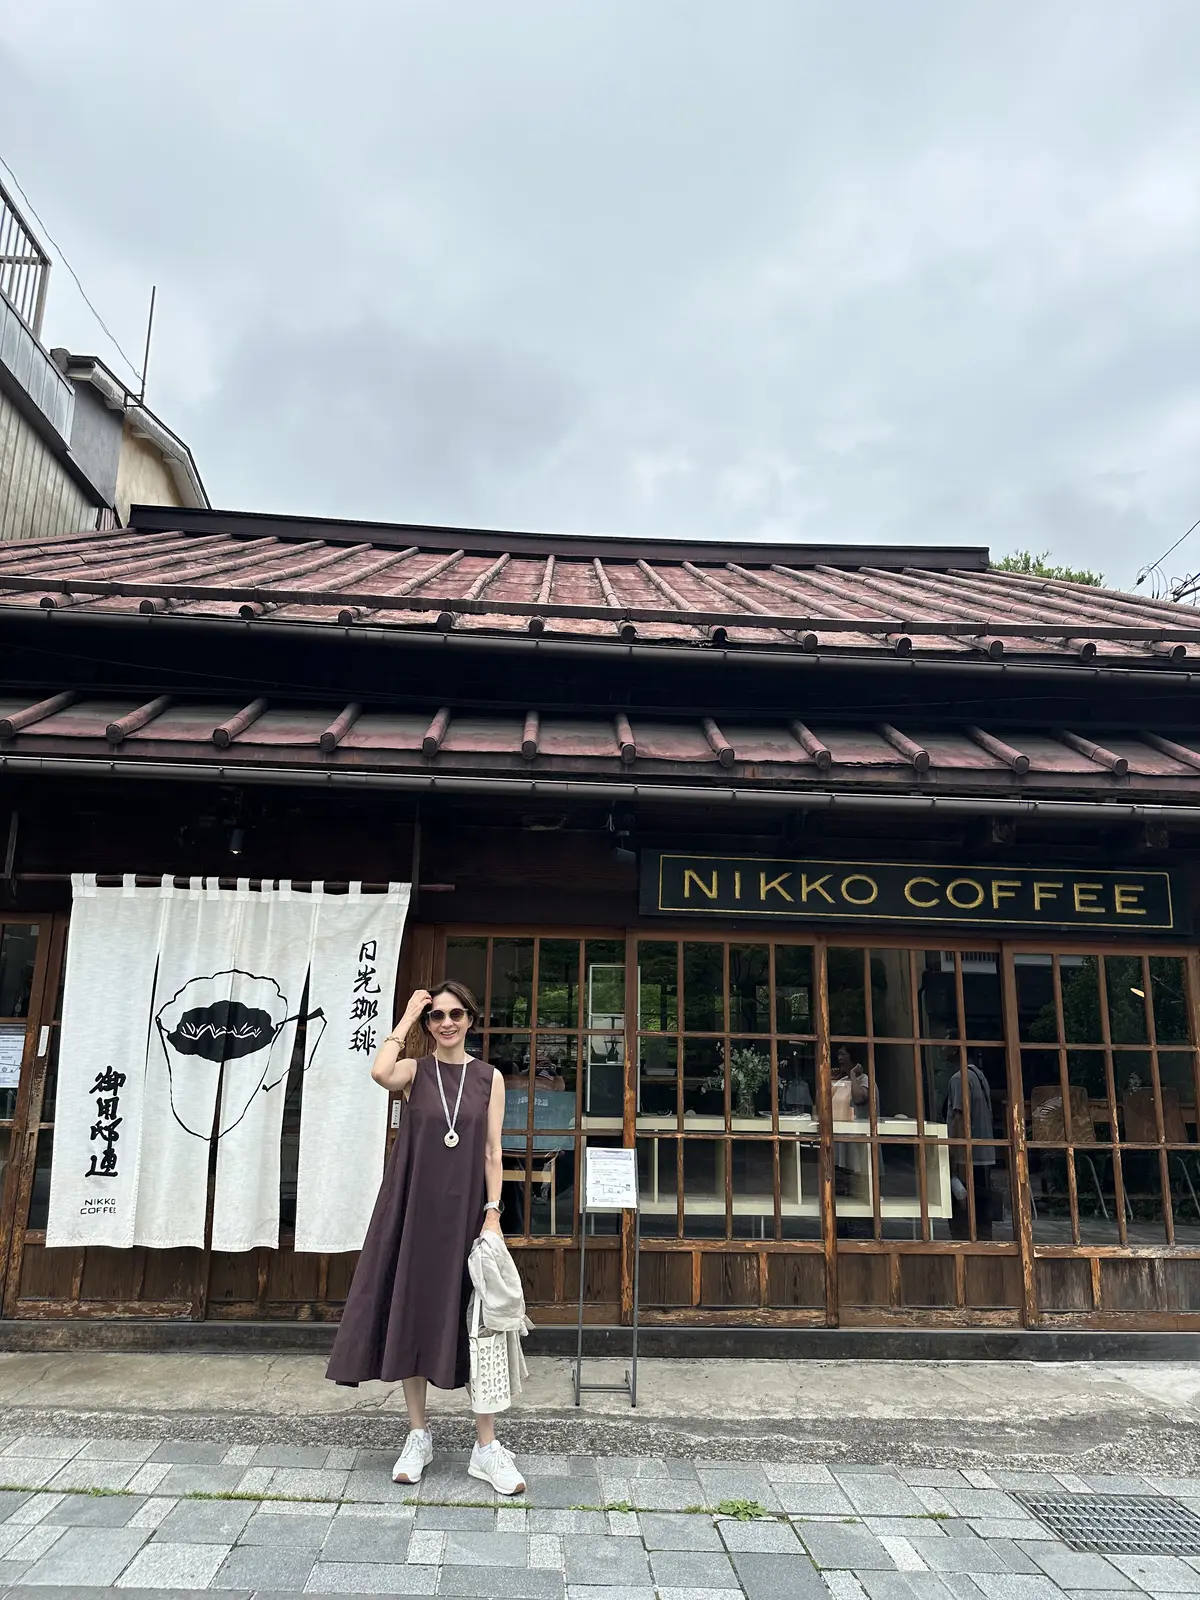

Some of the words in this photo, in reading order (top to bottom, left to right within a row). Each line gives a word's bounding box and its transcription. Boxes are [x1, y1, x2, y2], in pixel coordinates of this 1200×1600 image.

[683, 868, 879, 905] NIKKO
[903, 876, 1147, 915] COFFEE
[348, 939, 381, 1056] 日光珈琲
[84, 1198, 116, 1206] NIKKO
